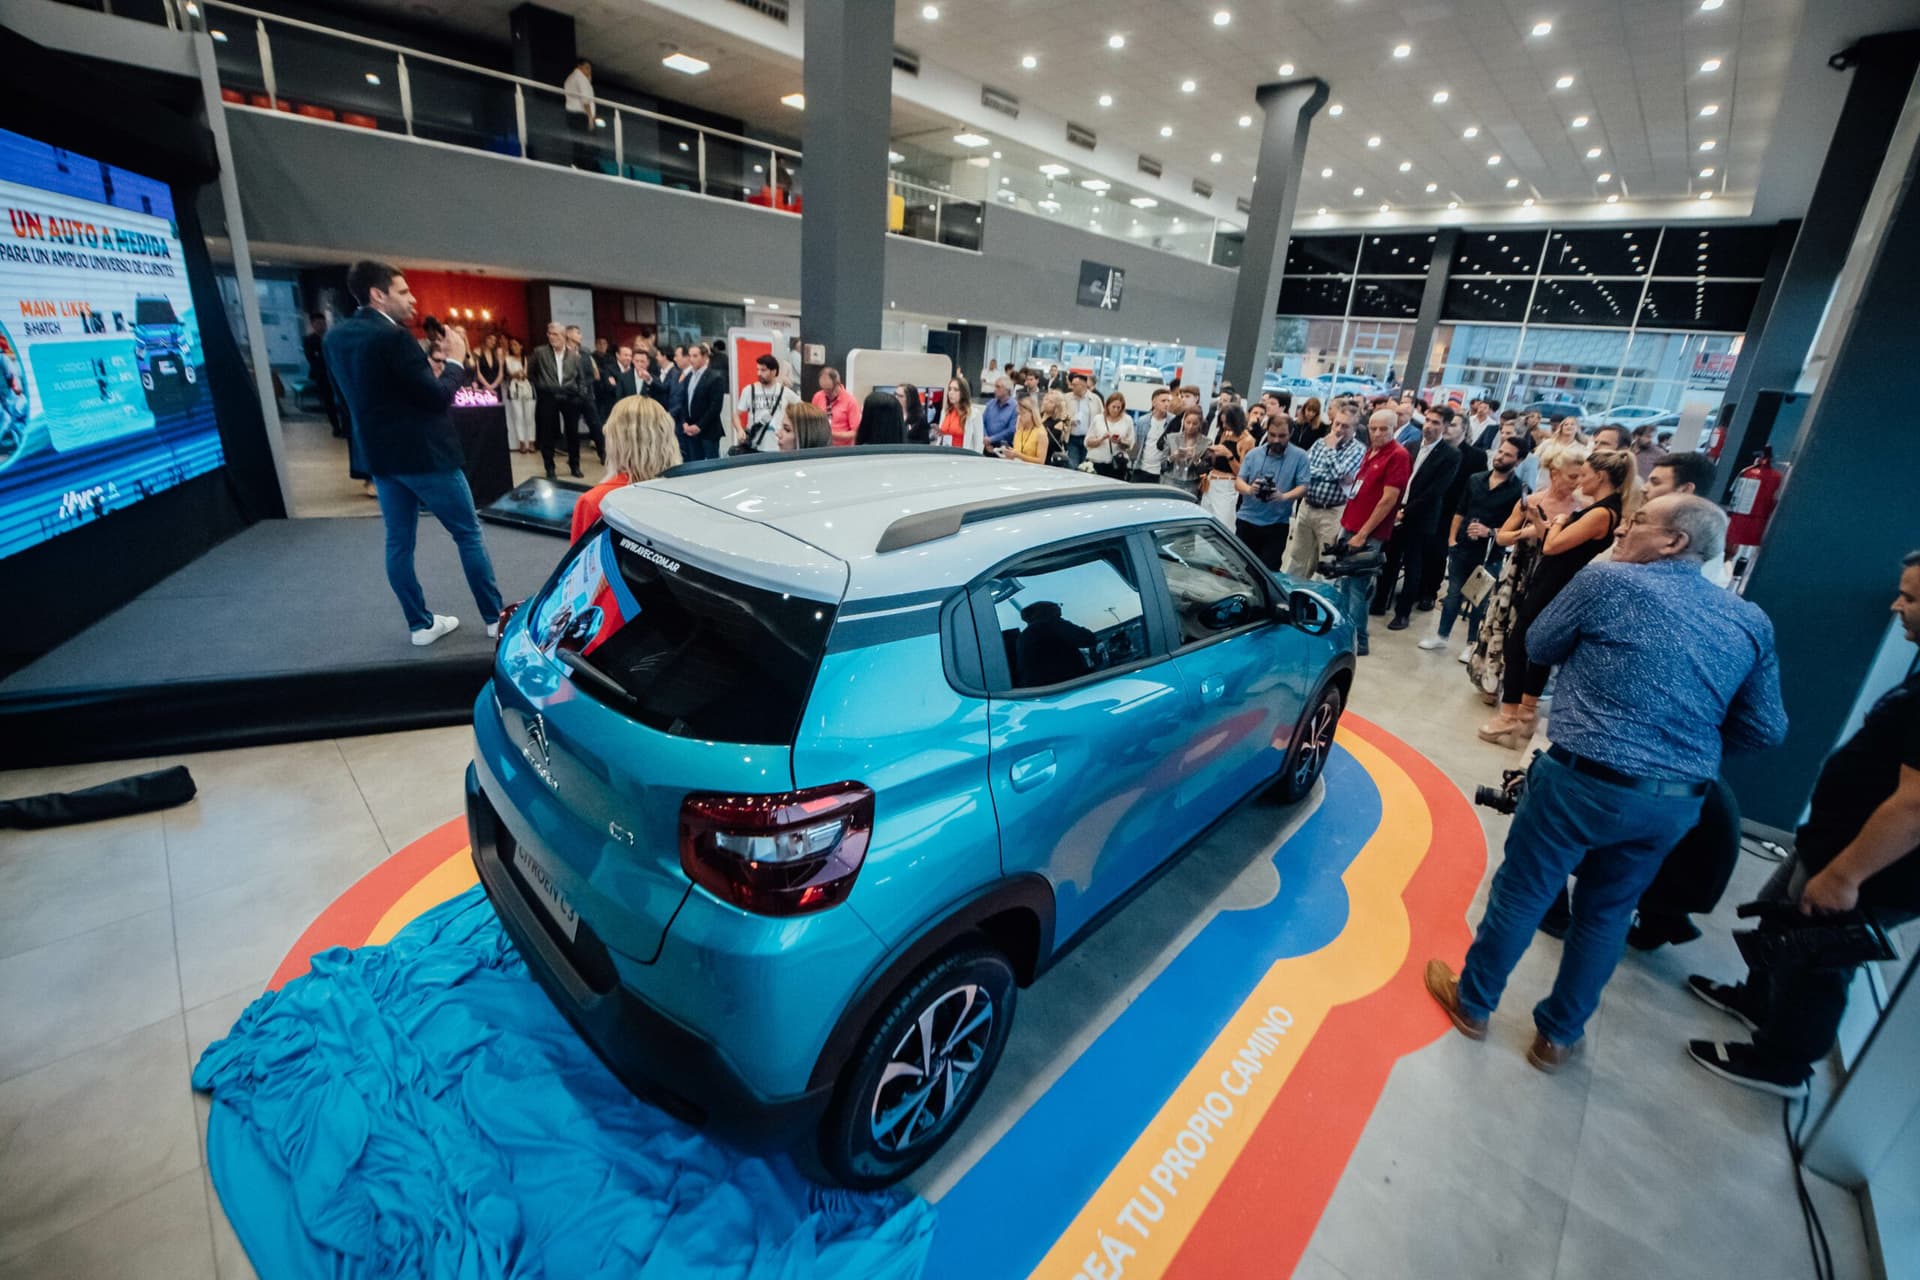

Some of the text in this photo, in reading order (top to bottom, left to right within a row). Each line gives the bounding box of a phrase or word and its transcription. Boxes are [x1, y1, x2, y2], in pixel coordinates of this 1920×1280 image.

[8, 208, 171, 260] UN AUTO A MEDIDA
[0, 243, 32, 263] PARA
[31, 246, 50, 264] UN
[52, 249, 88, 269] AMPLIO
[132, 259, 143, 274] DE
[20, 299, 57, 317] MAIN
[1116, 1184, 1165, 1239] TU
[1149, 1091, 1234, 1198] PROPIO
[1220, 1004, 1295, 1097] CAMINO
